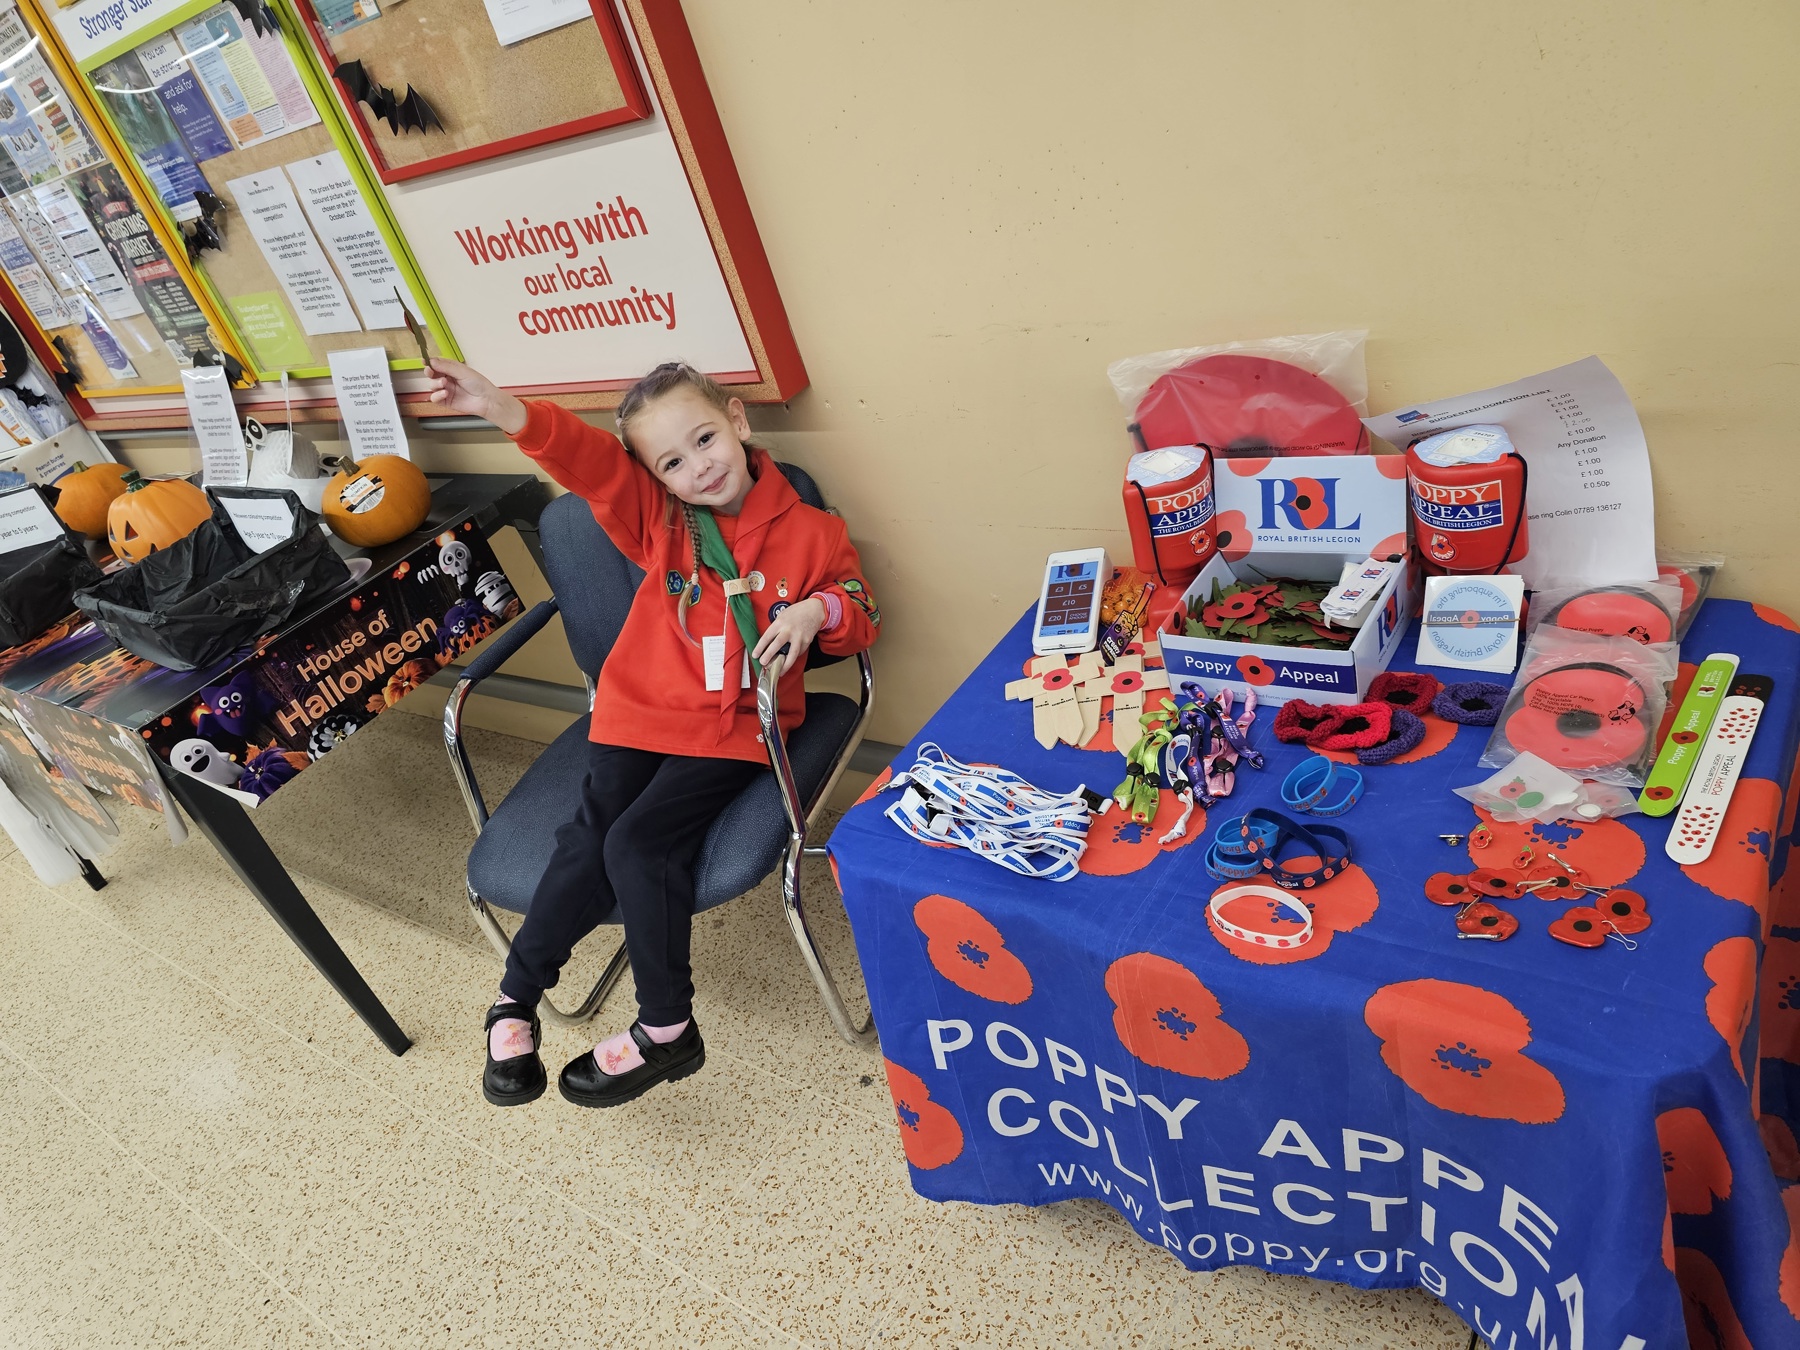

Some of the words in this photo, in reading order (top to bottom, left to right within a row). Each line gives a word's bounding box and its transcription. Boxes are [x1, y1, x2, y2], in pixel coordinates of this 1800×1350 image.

[79, 0, 128, 39] Stronger
[141, 51, 156, 62] You
[155, 44, 168, 58] can
[164, 85, 176, 100] and
[175, 79, 186, 95] ask
[184, 78, 194, 91] for
[312, 196, 330, 204] coloured
[104, 212, 148, 240] CHRISTMAS
[328, 214, 345, 222] October
[454, 216, 579, 266] Working
[573, 195, 649, 246] with
[120, 235, 156, 258] MARKET
[524, 272, 559, 296] our
[556, 256, 614, 292] local
[518, 286, 677, 336] community
[1428, 406, 1481, 424] SUGGESTED
[1482, 394, 1529, 410] DONATION
[1573, 434, 1606, 446] Donation
[1575, 426, 1596, 435] 10.00
[36, 462, 50, 472] Peanut
[50, 454, 64, 464] butter
[44, 462, 66, 477] preserves
[1157, 476, 1211, 514] POPP
[1590, 480, 1610, 488] 0.50p
[1158, 494, 1214, 526] APPEA
[1574, 507, 1594, 515] 07789
[1596, 503, 1622, 512] 136127
[1173, 523, 1193, 532] ROYAL
[1433, 520, 1461, 528] BRITISH
[1462, 518, 1492, 528] LEGION
[297, 632, 367, 682] House
[368, 609, 390, 636] of
[276, 618, 438, 737] Halloween
[1184, 656, 1232, 675] Poppy
[1280, 666, 1340, 684] Appeal
[1668, 745, 1688, 765] Poppy
[1684, 710, 1700, 731] Appeal
[58, 742, 144, 786] Halloween
[1711, 777, 1726, 796] POPPY
[1721, 754, 1736, 776] APPEAL
[946, 788, 959, 800] Poppy
[966, 802, 980, 814] Appeal
[992, 792, 1006, 804] Poppy
[1064, 820, 1080, 830] Poppy
[927, 1020, 1200, 1140] POPPY
[1258, 1119, 1646, 1350] APPEA
